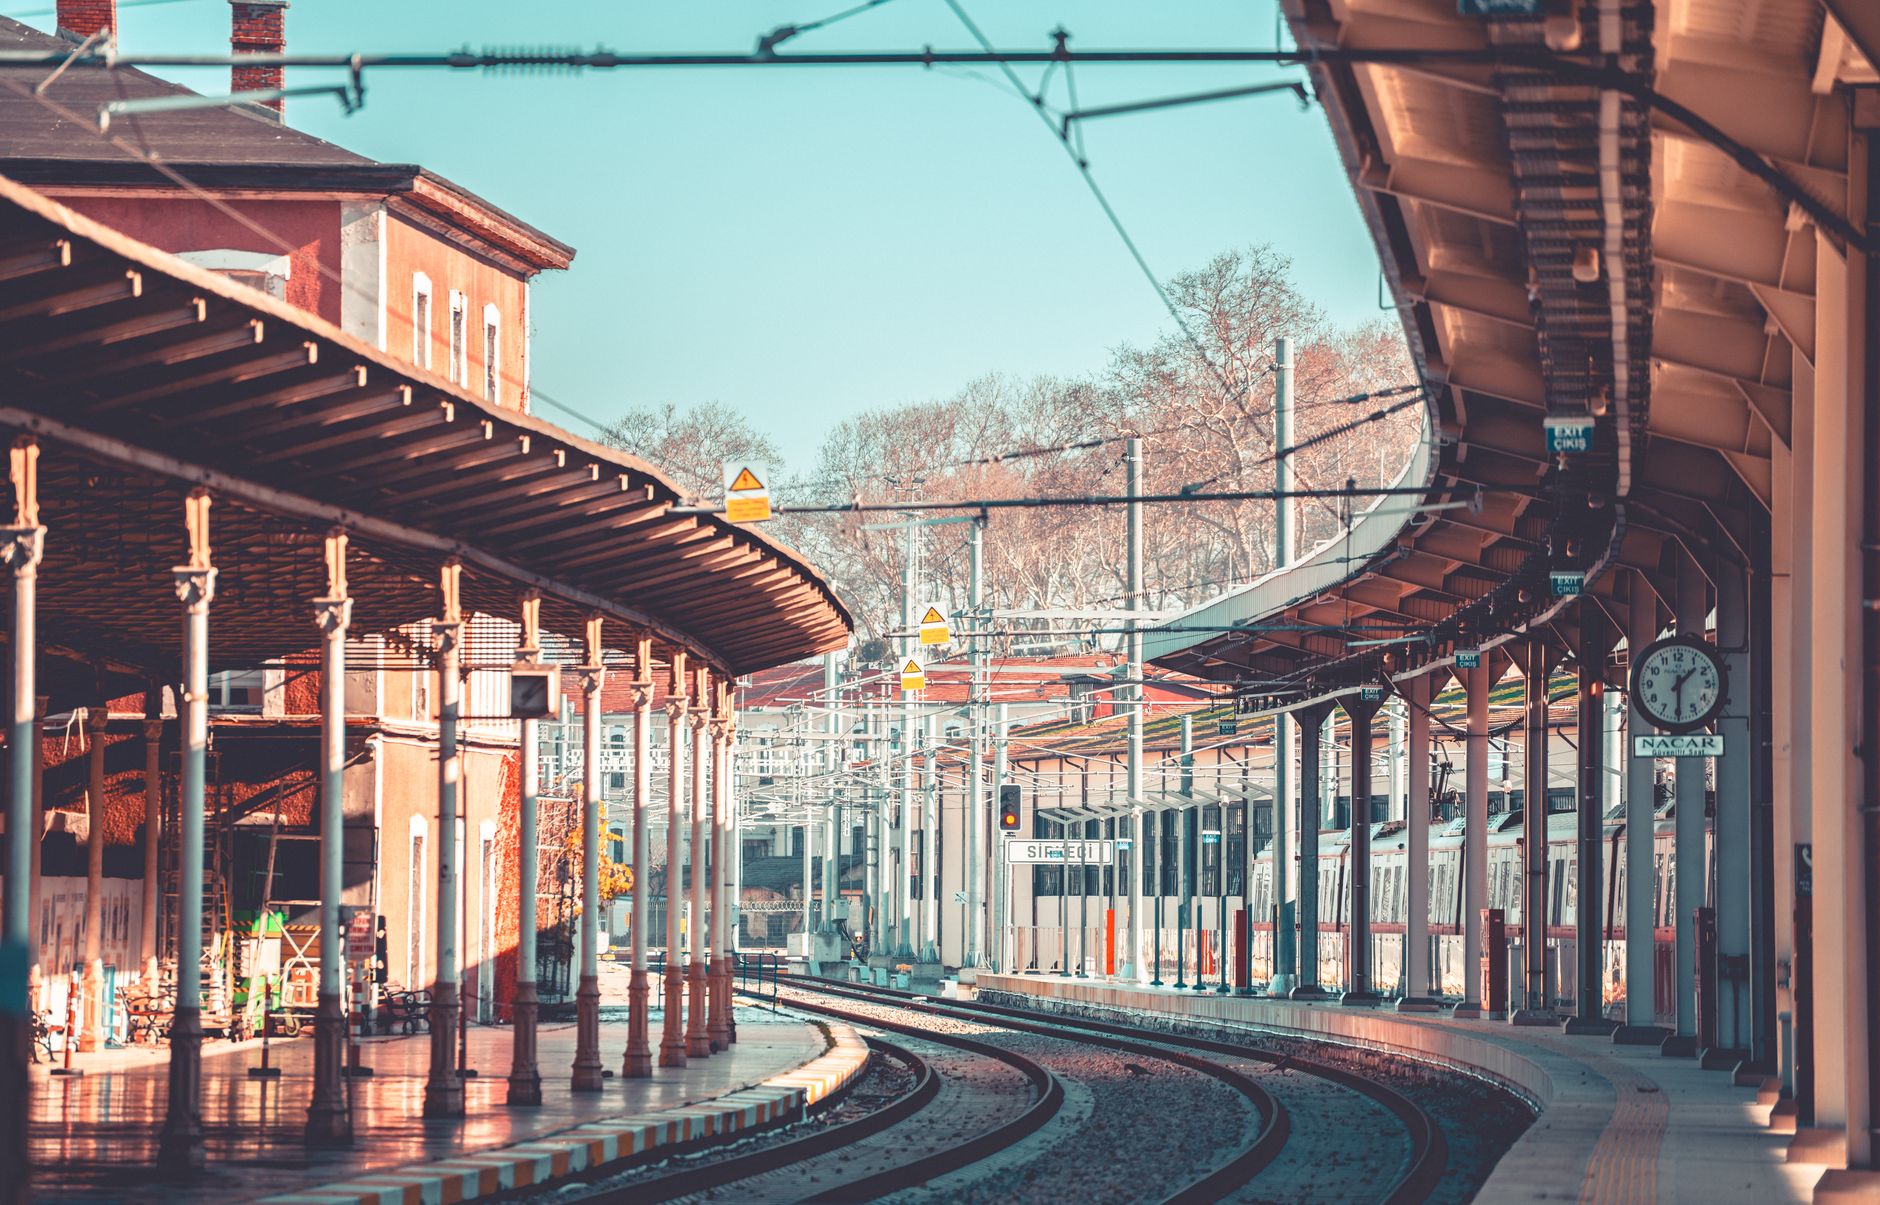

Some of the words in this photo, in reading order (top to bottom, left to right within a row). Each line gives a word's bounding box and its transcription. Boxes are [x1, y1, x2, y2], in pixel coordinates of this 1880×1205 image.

[1554, 425, 1584, 437] EXIT
[1554, 438, 1586, 450] ÇIKIŞ
[1557, 576, 1577, 585] EXIT
[1661, 657, 1668, 666] 11
[1673, 652, 1684, 662] 12
[1650, 666, 1660, 676] 10
[1700, 666, 1708, 676] 2
[1646, 679, 1653, 689] 9
[1704, 679, 1711, 689] 3
[1650, 693, 1657, 703] 8
[1661, 703, 1667, 713] 7
[1690, 703, 1697, 713] 5
[1642, 738, 1715, 748] NACAR
